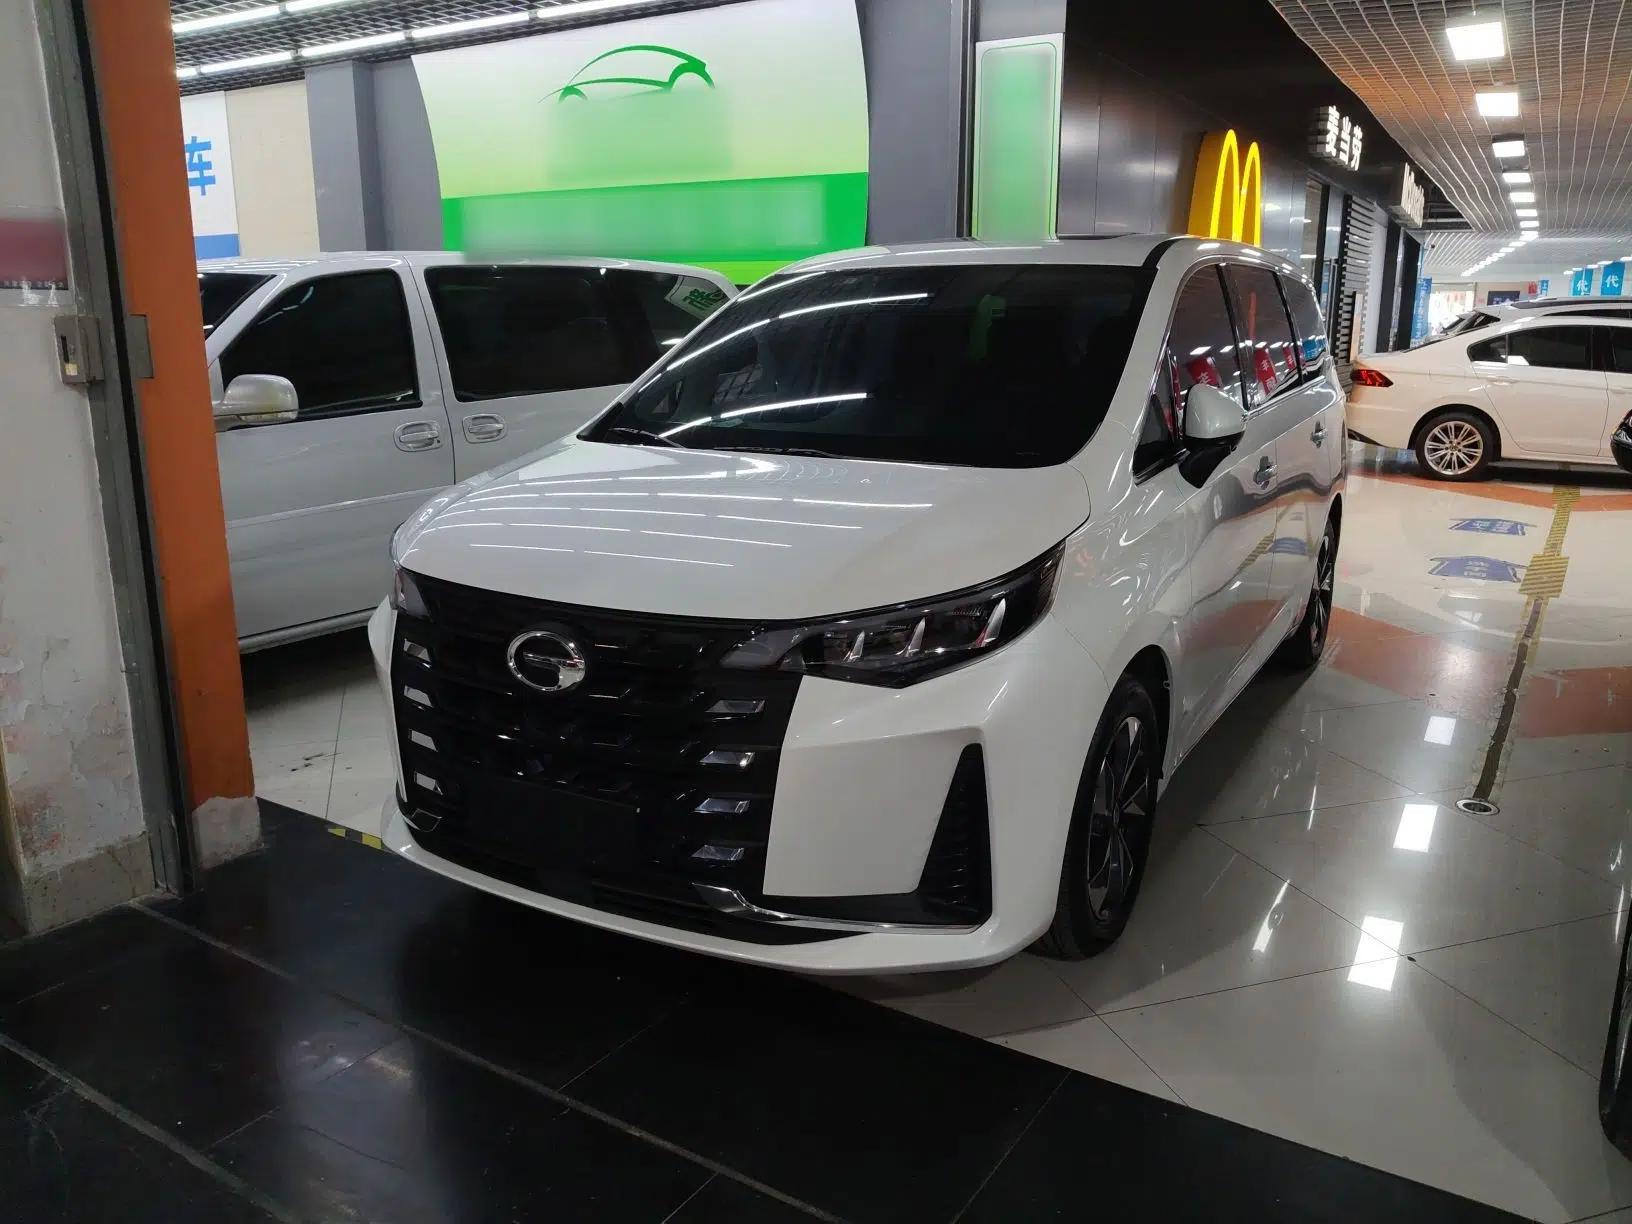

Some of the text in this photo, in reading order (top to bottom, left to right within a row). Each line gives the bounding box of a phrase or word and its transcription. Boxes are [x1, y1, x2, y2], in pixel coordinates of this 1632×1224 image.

[185, 136, 216, 195] 车
[1325, 105, 1363, 171] 麦当劳
